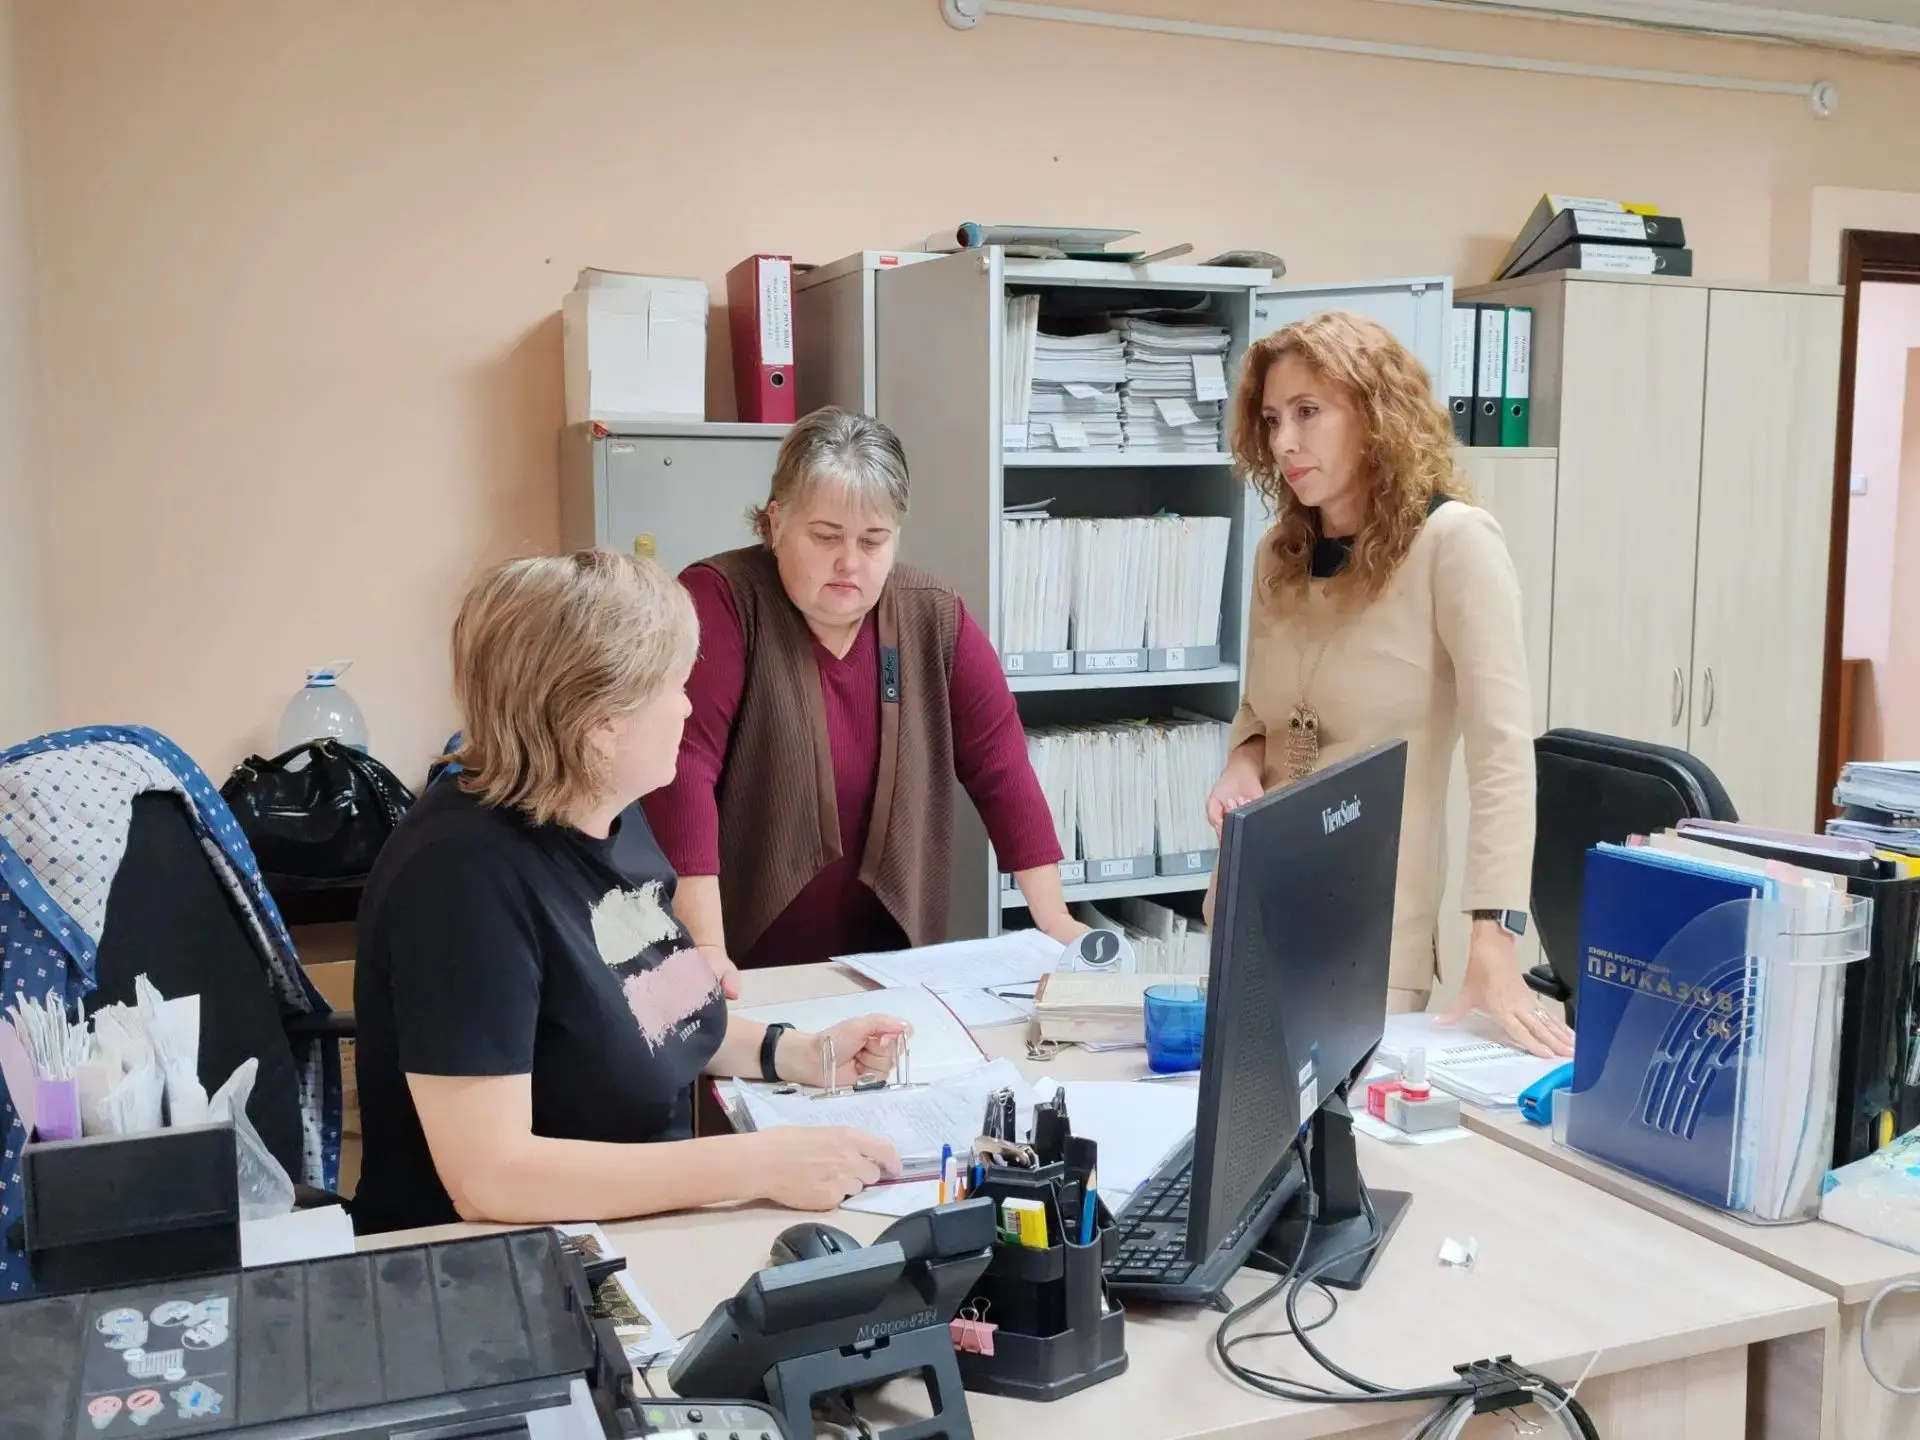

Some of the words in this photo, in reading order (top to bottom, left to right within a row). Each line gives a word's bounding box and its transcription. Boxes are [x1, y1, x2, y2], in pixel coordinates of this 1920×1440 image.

[1322, 793, 1362, 836] ViewSonic
[1588, 946, 1613, 960] КНИГА
[1588, 955, 1733, 1017] ПРИКАЗОВ
